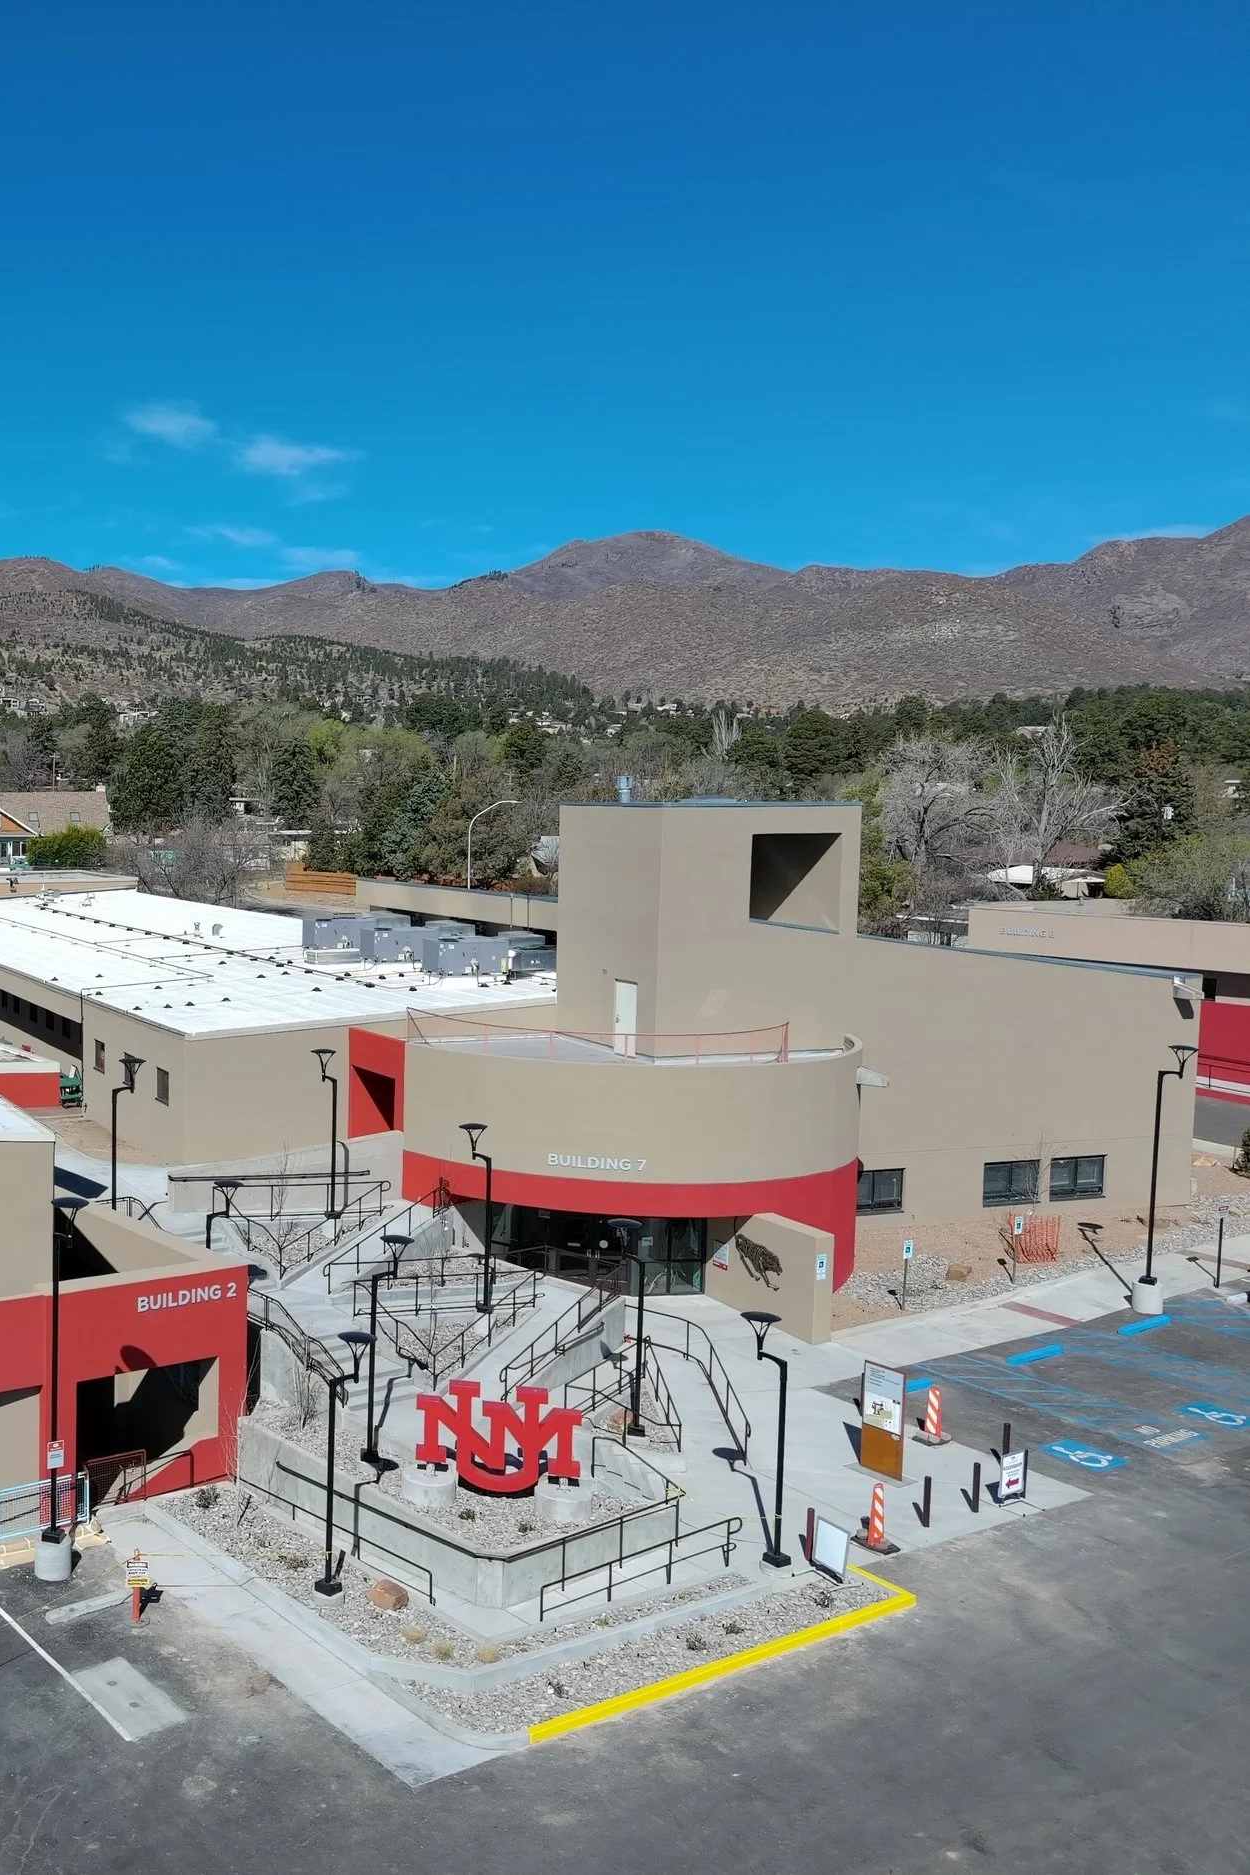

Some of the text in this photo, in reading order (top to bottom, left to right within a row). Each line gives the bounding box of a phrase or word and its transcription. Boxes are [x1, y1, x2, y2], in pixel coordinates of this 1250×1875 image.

[1000, 926, 1047, 938] BUILDING
[548, 1153, 647, 1171] BUILDING 7
[137, 1282, 237, 1313] BUILDING 2
[1133, 1425, 1160, 1436] NO
[1143, 1428, 1201, 1449] PARKING
